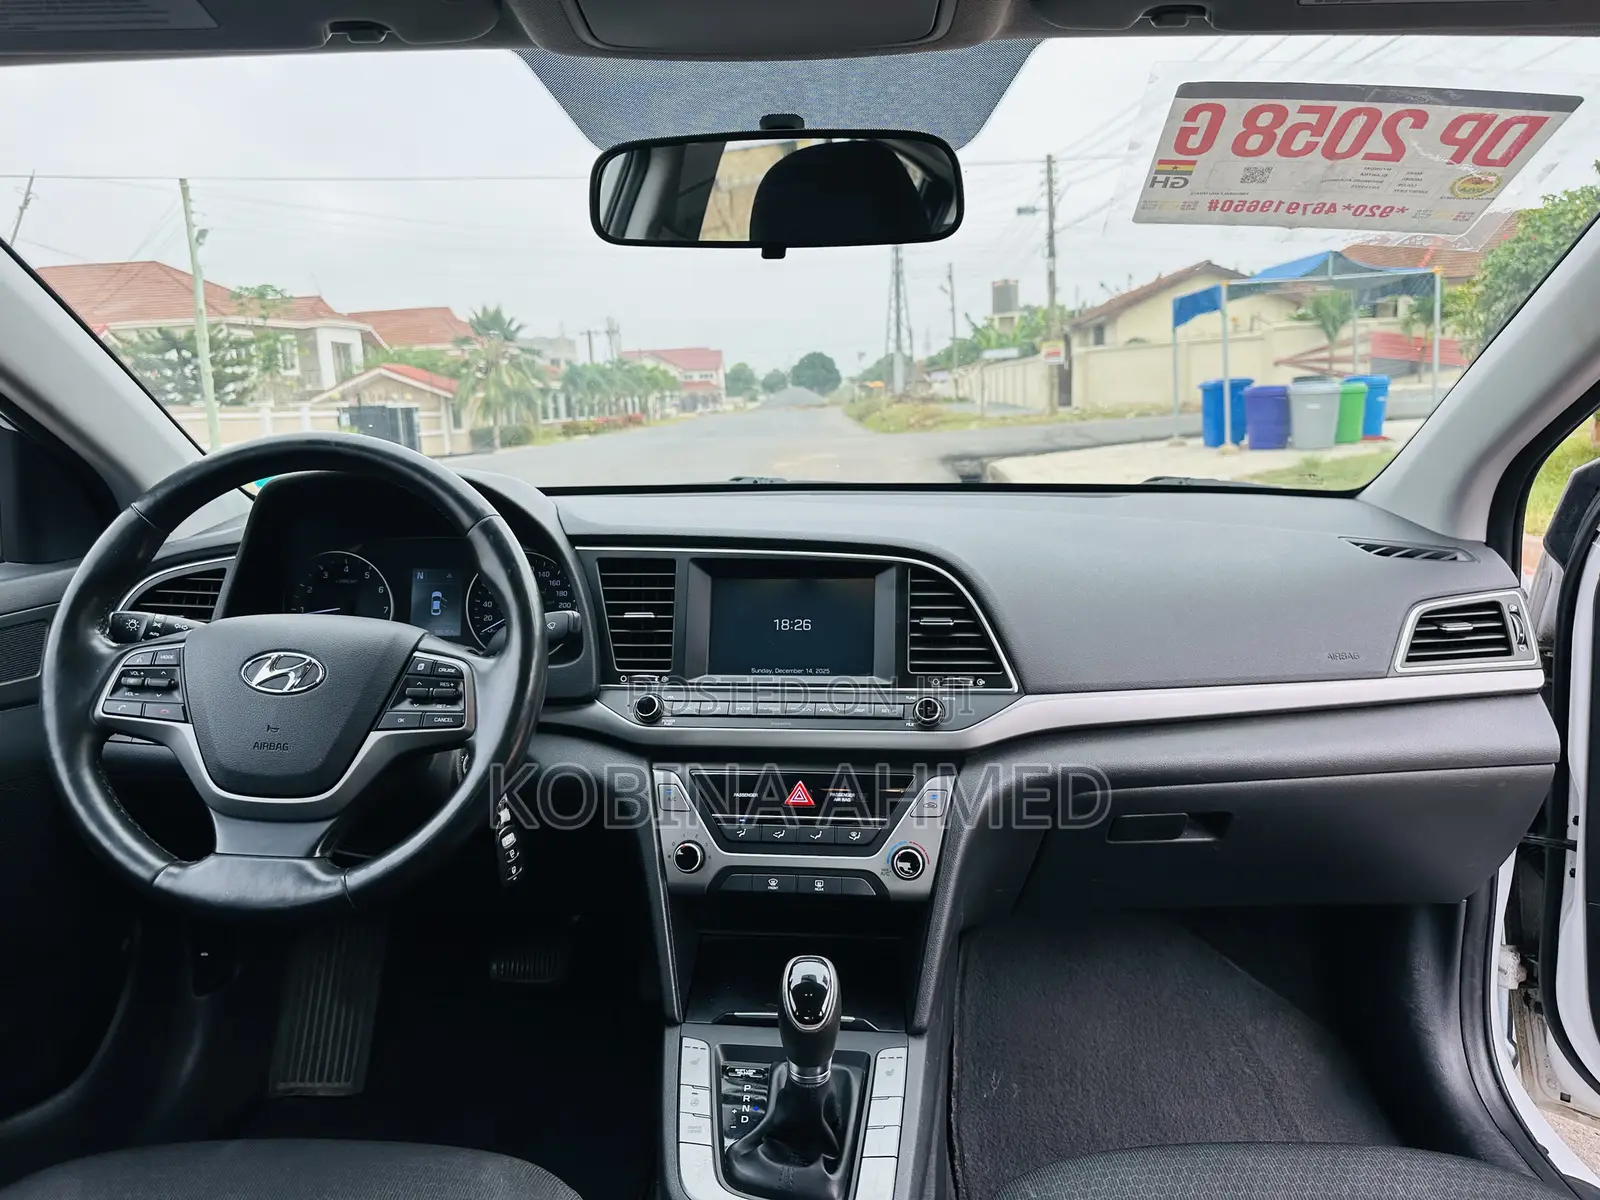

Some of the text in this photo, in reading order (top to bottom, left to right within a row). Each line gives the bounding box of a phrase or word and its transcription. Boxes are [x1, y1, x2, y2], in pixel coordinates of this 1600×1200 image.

[773, 618, 812, 631] 18:26
[1327, 652, 1360, 660] AIRBAG
[252, 741, 289, 751] AIRBAG
